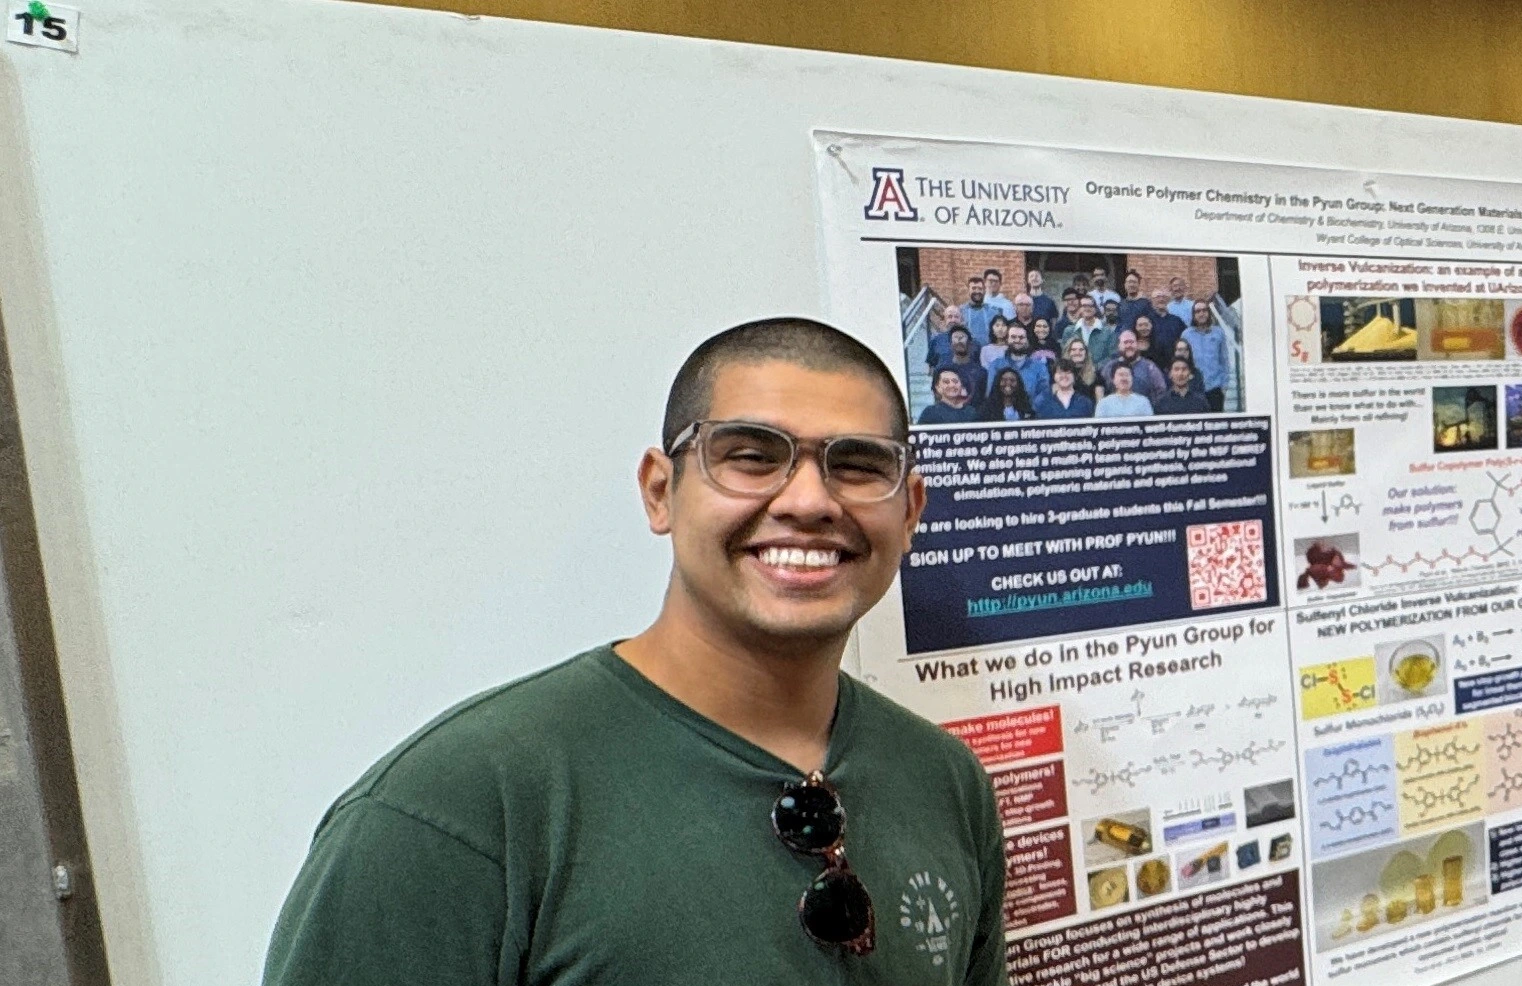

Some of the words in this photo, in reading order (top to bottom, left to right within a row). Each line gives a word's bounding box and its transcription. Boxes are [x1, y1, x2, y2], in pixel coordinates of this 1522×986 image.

[15, 12, 67, 41] 15
[915, 176, 955, 198] THE
[960, 179, 1070, 204] UNIVERSITY
[1085, 181, 1142, 198] Organic
[1146, 185, 1202, 202] Polymer
[1205, 189, 1271, 207] Chemistry
[1274, 193, 1286, 206] in
[1289, 195, 1309, 207] the
[1312, 195, 1342, 211] Pyun
[934, 205, 960, 224] OF
[918, 432, 951, 446] Pyun
[952, 431, 989, 445] group
[990, 429, 1001, 440] is
[1003, 430, 1018, 440] an
[922, 447, 942, 459] the
[945, 446, 978, 457] areas
[980, 443, 993, 456] of
[966, 459, 986, 471] We
[923, 472, 980, 488] ROGRAM
[982, 472, 1005, 484] and
[930, 521, 952, 532] are
[954, 516, 1003, 530] looking
[1005, 514, 1018, 526] to
[1020, 512, 1045, 524] hire
[1163, 501, 1184, 513] this
[909, 549, 948, 567] SIGN
[952, 547, 974, 563] UP
[976, 545, 999, 560] TO
[1001, 540, 1043, 558] MEET
[1044, 537, 1082, 553] WITH
[1084, 533, 1122, 550] PROF
[991, 572, 1044, 591] CHECK
[1046, 569, 1067, 585] US
[1069, 565, 1100, 582] OUT
[967, 581, 1152, 617] http://pyun.arizona.edu
[1317, 624, 1346, 637] NEW
[1455, 603, 1488, 617] FROM
[914, 658, 979, 682] What
[985, 656, 1016, 672] we
[1024, 648, 1052, 667] do
[1059, 644, 1078, 662] in
[1085, 641, 1118, 658] the
[1125, 633, 1177, 655] Pyun
[1183, 624, 1243, 645] Group
[1248, 618, 1275, 635] for
[989, 677, 1042, 701] High
[1049, 666, 1122, 692] Impact
[1128, 651, 1222, 680] Research
[1022, 933, 1063, 951] Group
[1065, 920, 1114, 940] focuses
[1116, 915, 1132, 927] on
[1042, 944, 1070, 962] FOR
